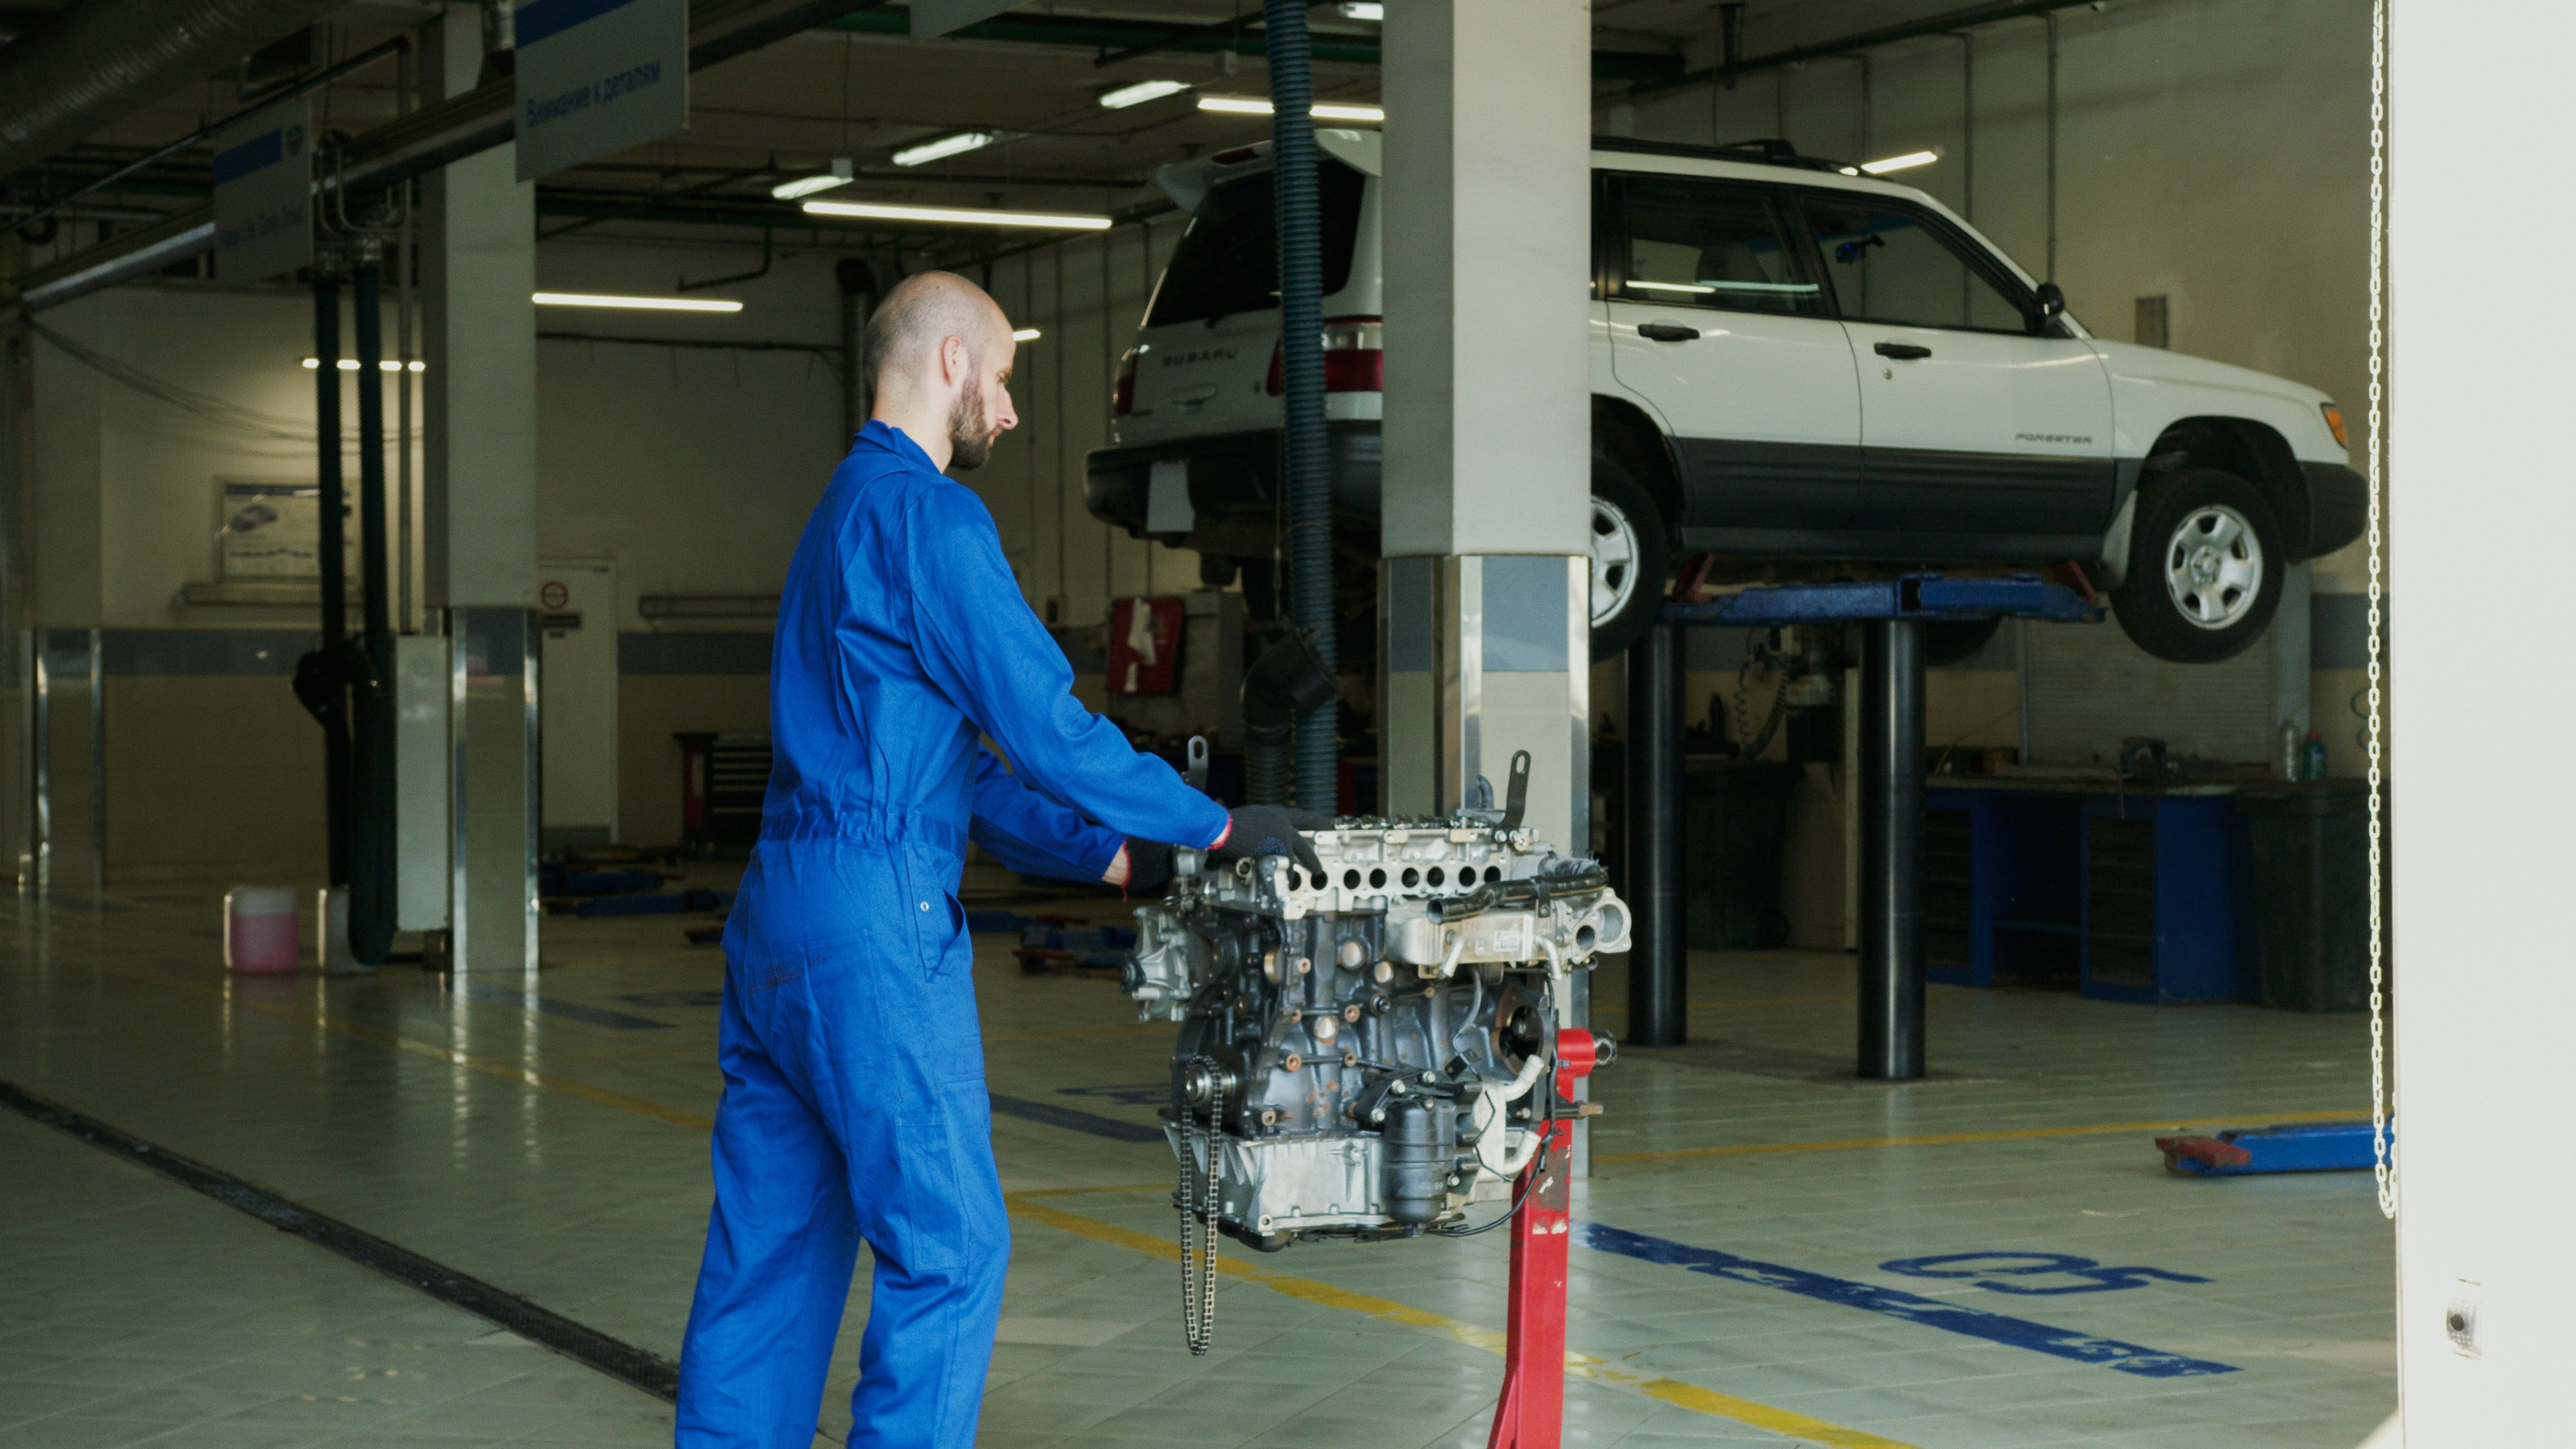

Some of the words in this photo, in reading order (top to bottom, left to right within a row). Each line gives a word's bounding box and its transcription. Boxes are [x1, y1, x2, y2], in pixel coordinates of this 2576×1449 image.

[527, 86, 590, 127] Внимание
[603, 59, 660, 104] деталям
[1162, 346, 1239, 367] SUBARU
[2015, 432, 2092, 444] FORESTER
[1877, 1250, 2217, 1296] 05
